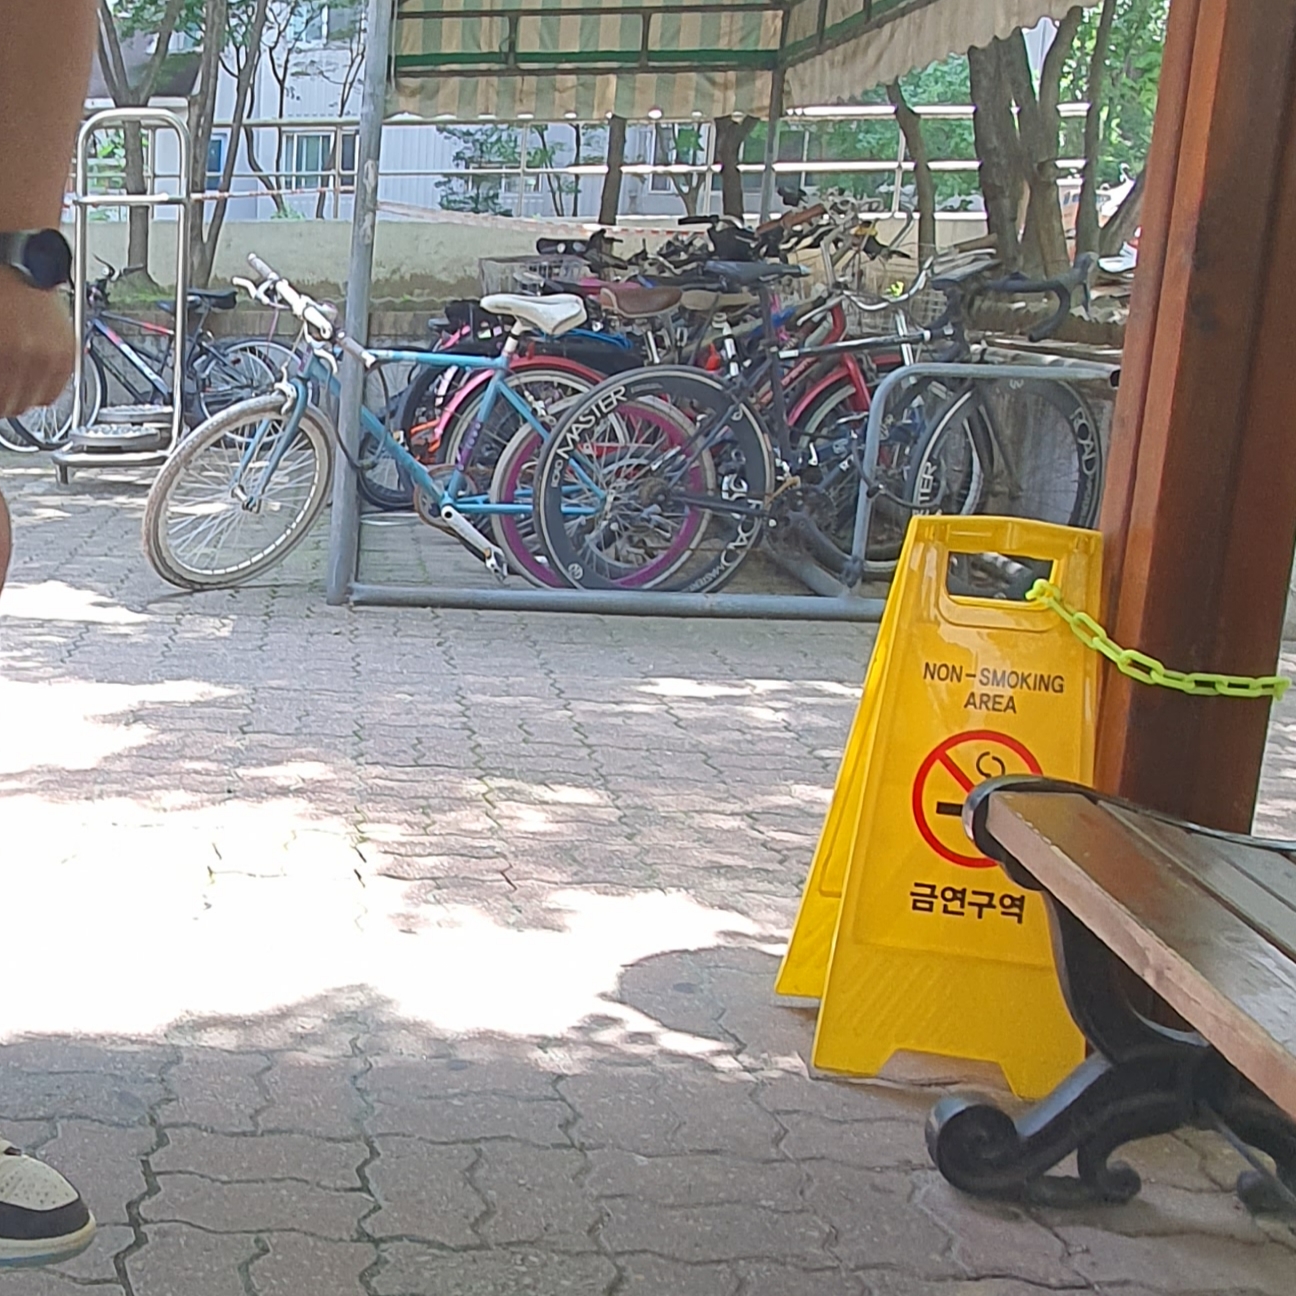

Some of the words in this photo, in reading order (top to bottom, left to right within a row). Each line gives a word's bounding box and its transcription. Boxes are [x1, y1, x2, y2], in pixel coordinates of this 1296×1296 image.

[556, 384, 628, 460] MASTER
[1069, 406, 1097, 475] ROAD
[923, 661, 1065, 694] NON-SMOKING
[963, 691, 1018, 715] AREA
[909, 881, 1026, 925] 금연구역
